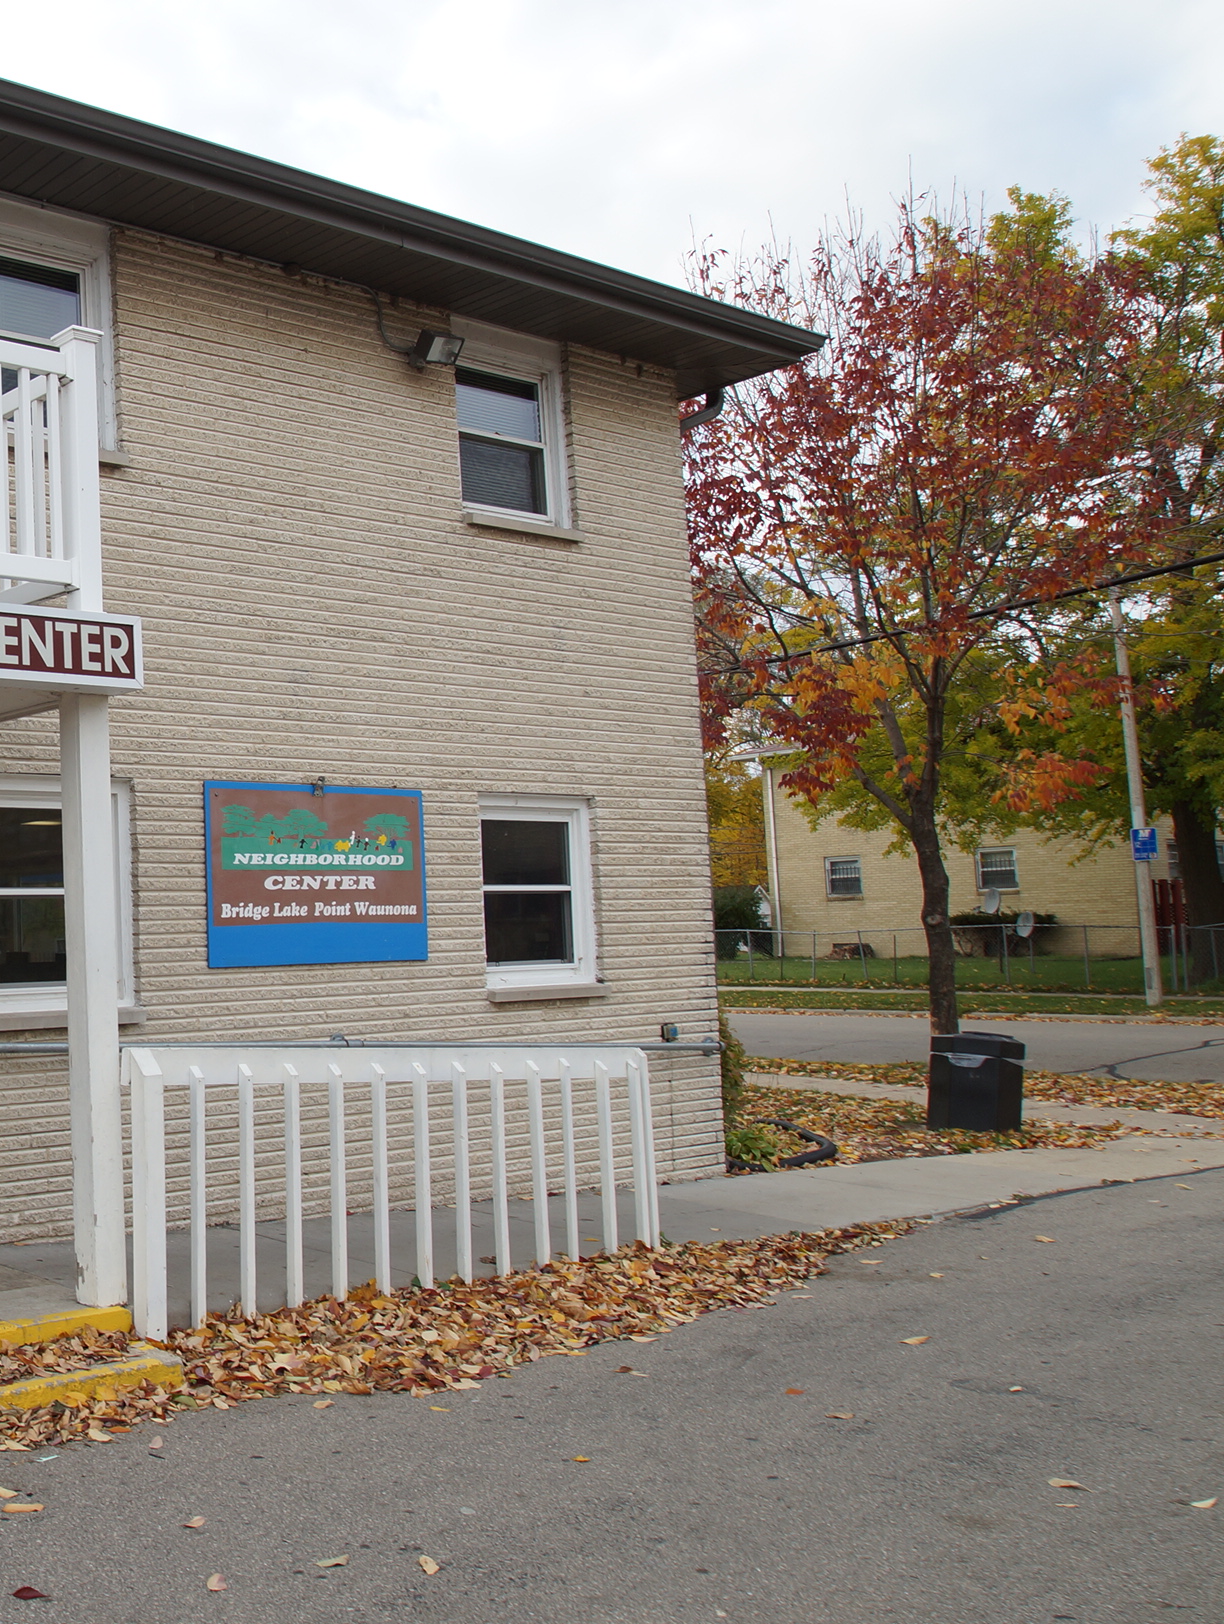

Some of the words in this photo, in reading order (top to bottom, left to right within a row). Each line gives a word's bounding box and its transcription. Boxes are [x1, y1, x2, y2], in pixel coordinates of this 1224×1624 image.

[233, 853, 404, 866] NEIGHBORHOOD
[264, 875, 376, 890] CENTER
[221, 902, 270, 920] Bridge
[273, 902, 308, 917] Lake
[314, 902, 351, 916] Point
[354, 902, 417, 916] Waunona
